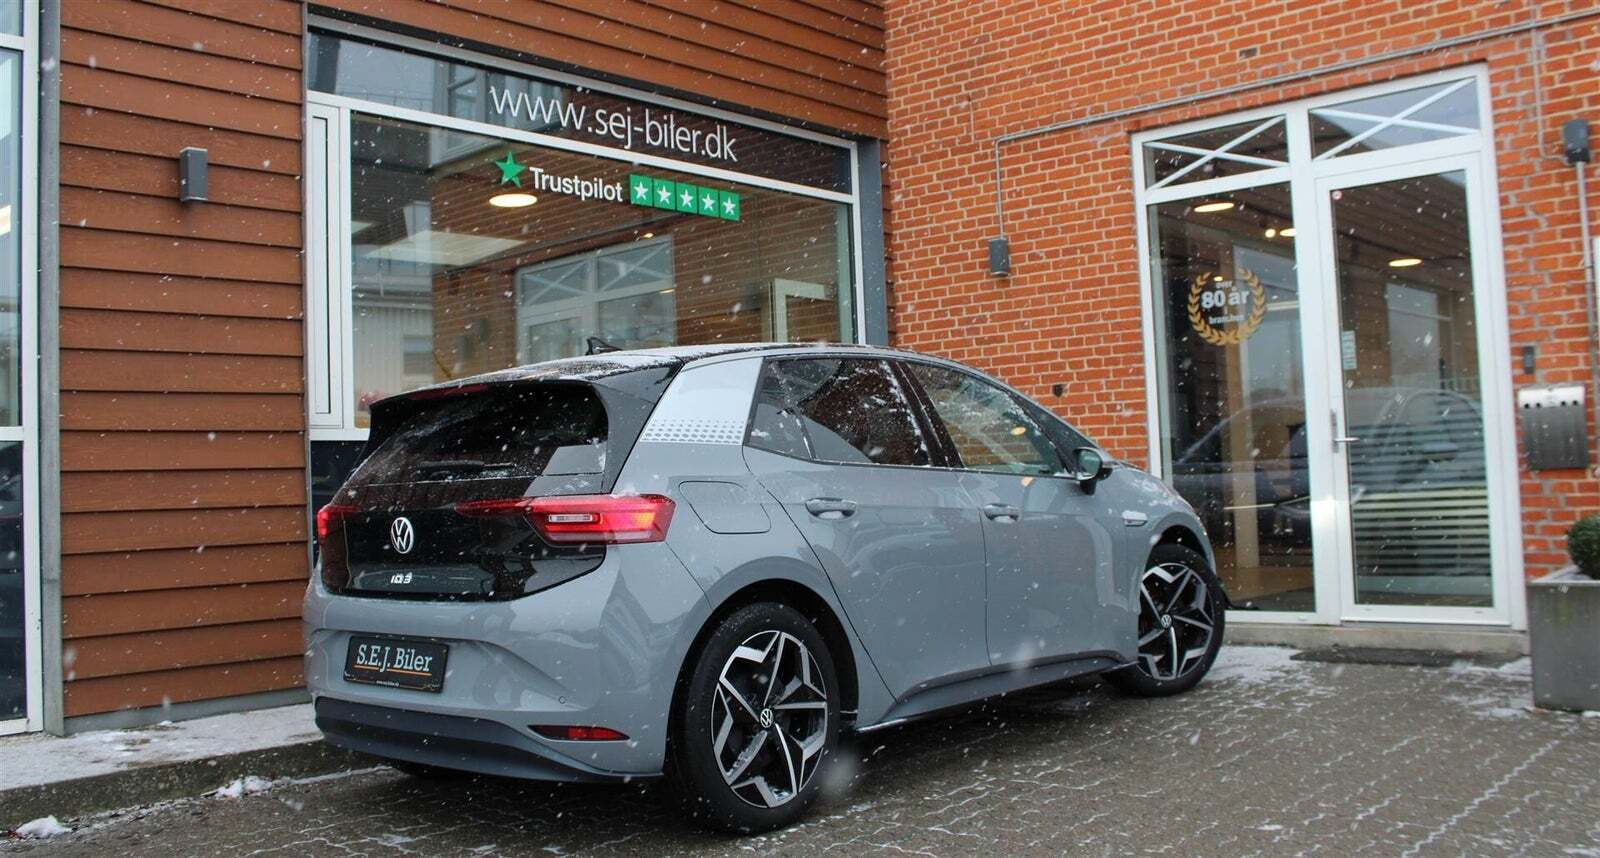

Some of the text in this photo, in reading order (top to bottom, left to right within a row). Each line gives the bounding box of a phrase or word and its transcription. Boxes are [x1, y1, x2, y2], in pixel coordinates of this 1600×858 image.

[489, 86, 738, 162] www.sej-biler.dk
[529, 167, 623, 202] Trustpilot
[1201, 286, 1249, 308] 80 år
[357, 644, 432, 672] S.E.J. Biler
